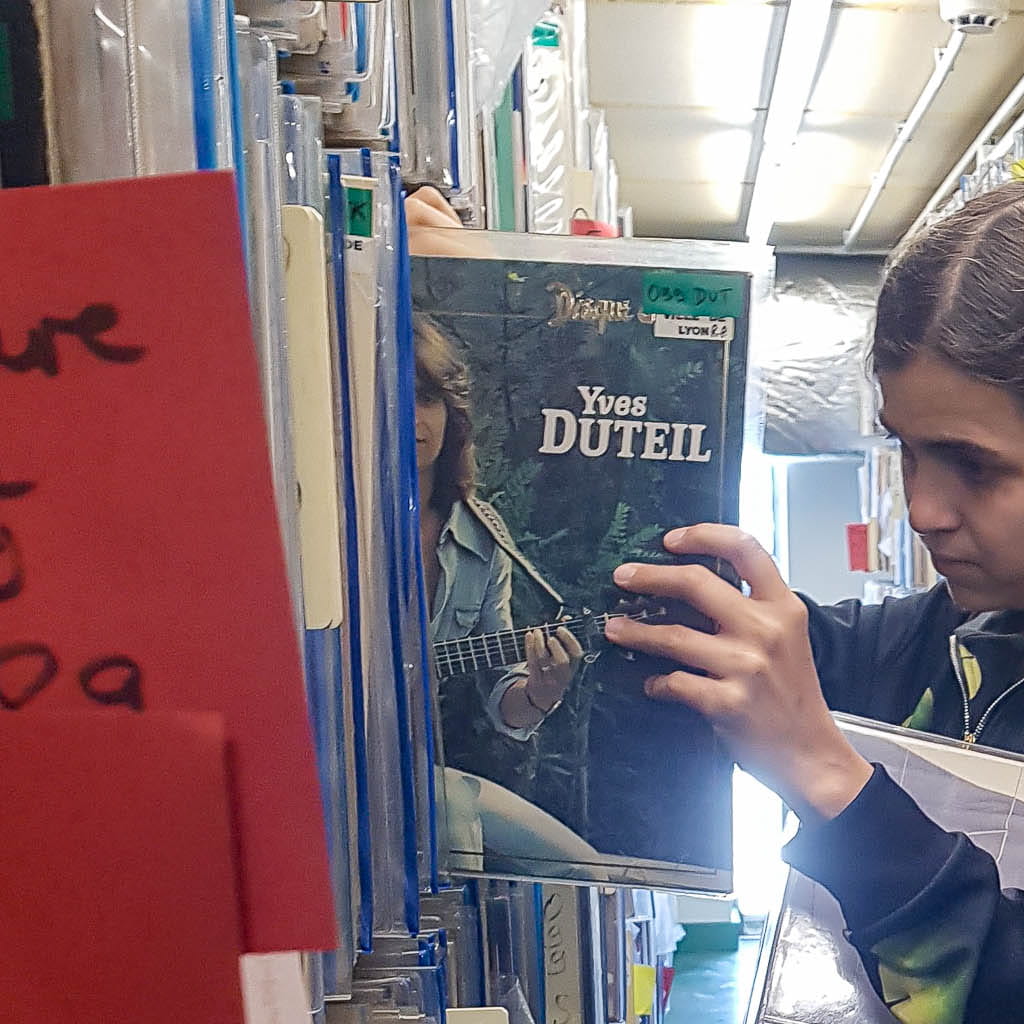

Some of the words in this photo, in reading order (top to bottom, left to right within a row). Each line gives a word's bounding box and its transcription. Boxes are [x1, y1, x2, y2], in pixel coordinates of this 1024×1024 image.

[693, 287, 733, 306] DUT
[577, 385, 648, 417] Yves
[538, 408, 712, 463] DUTEIL
